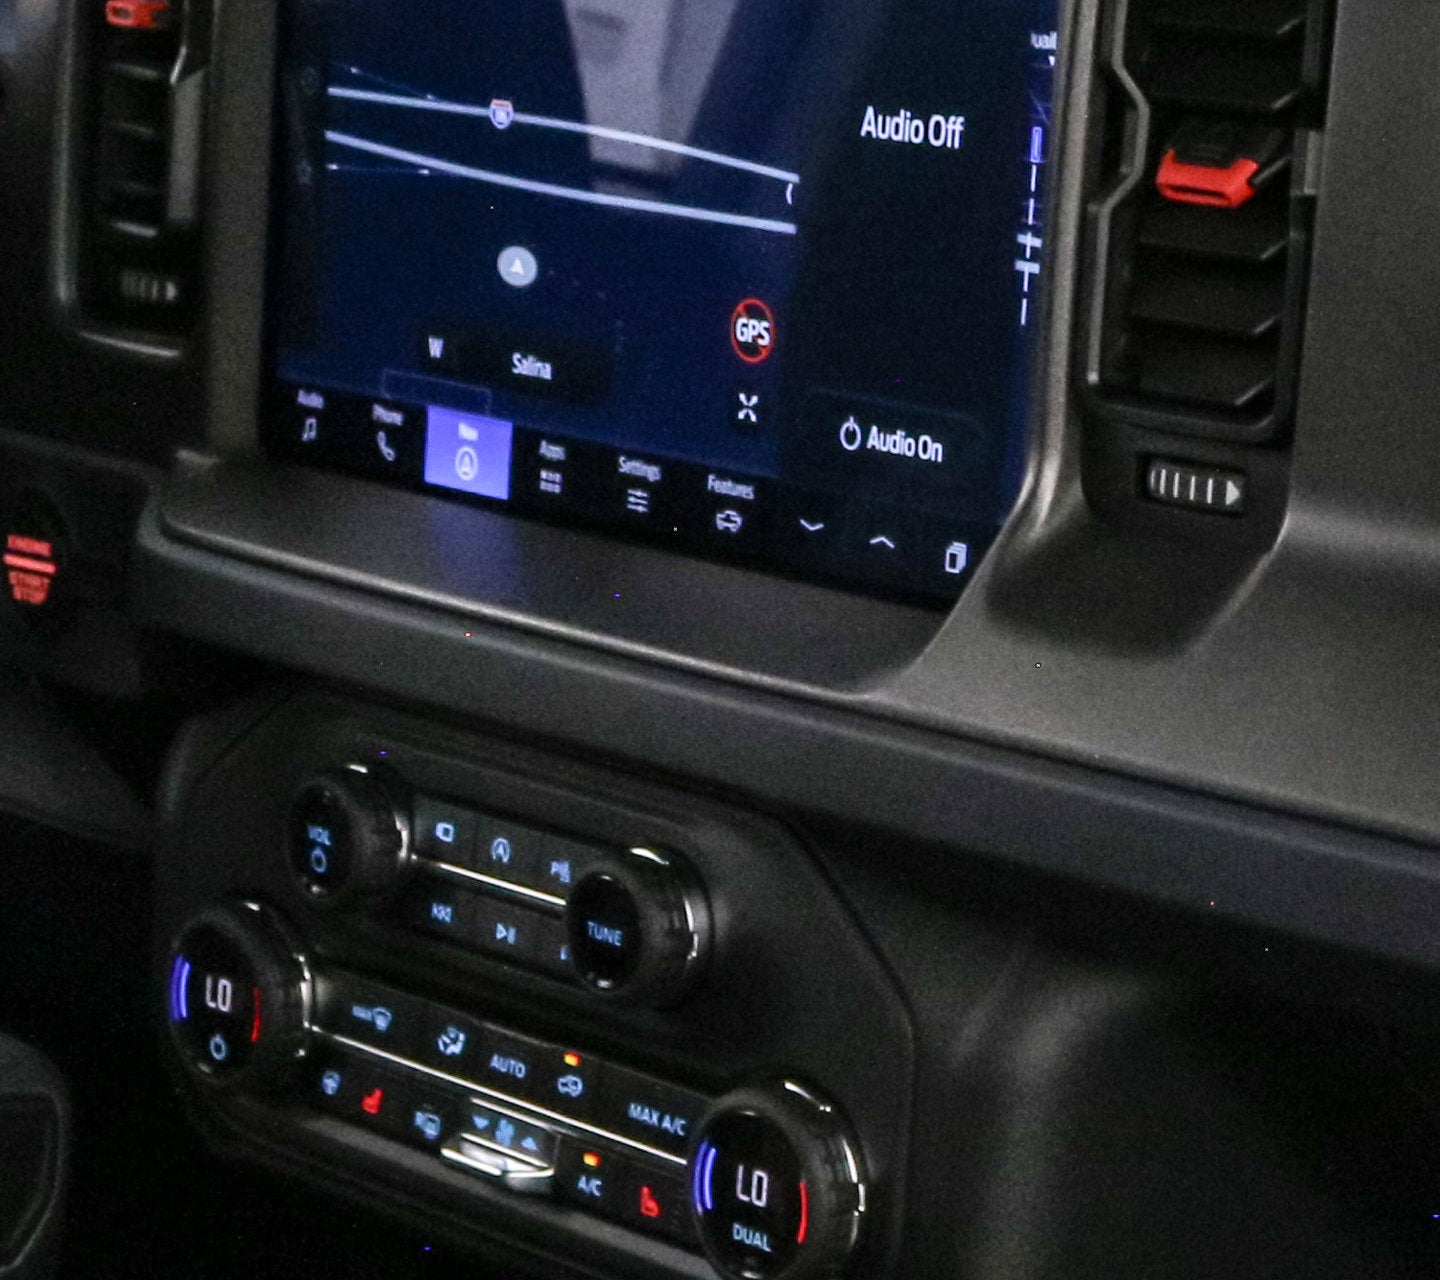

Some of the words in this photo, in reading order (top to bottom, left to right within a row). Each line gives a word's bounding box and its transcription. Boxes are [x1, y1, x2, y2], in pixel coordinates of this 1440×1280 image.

[860, 105, 924, 145] Audio
[927, 114, 965, 150] Off
[734, 317, 771, 348] GPS
[511, 351, 553, 381] Salina
[866, 424, 915, 459] Audio
[917, 434, 944, 463] On
[586, 920, 624, 947] TUNE
[205, 973, 233, 1014] LO
[489, 1053, 527, 1079] AUTO
[628, 1101, 660, 1128] MAX
[660, 1113, 688, 1137] A/C
[578, 1174, 603, 1198] A/C
[735, 1163, 770, 1208] LO
[732, 1222, 772, 1253] DUAL
